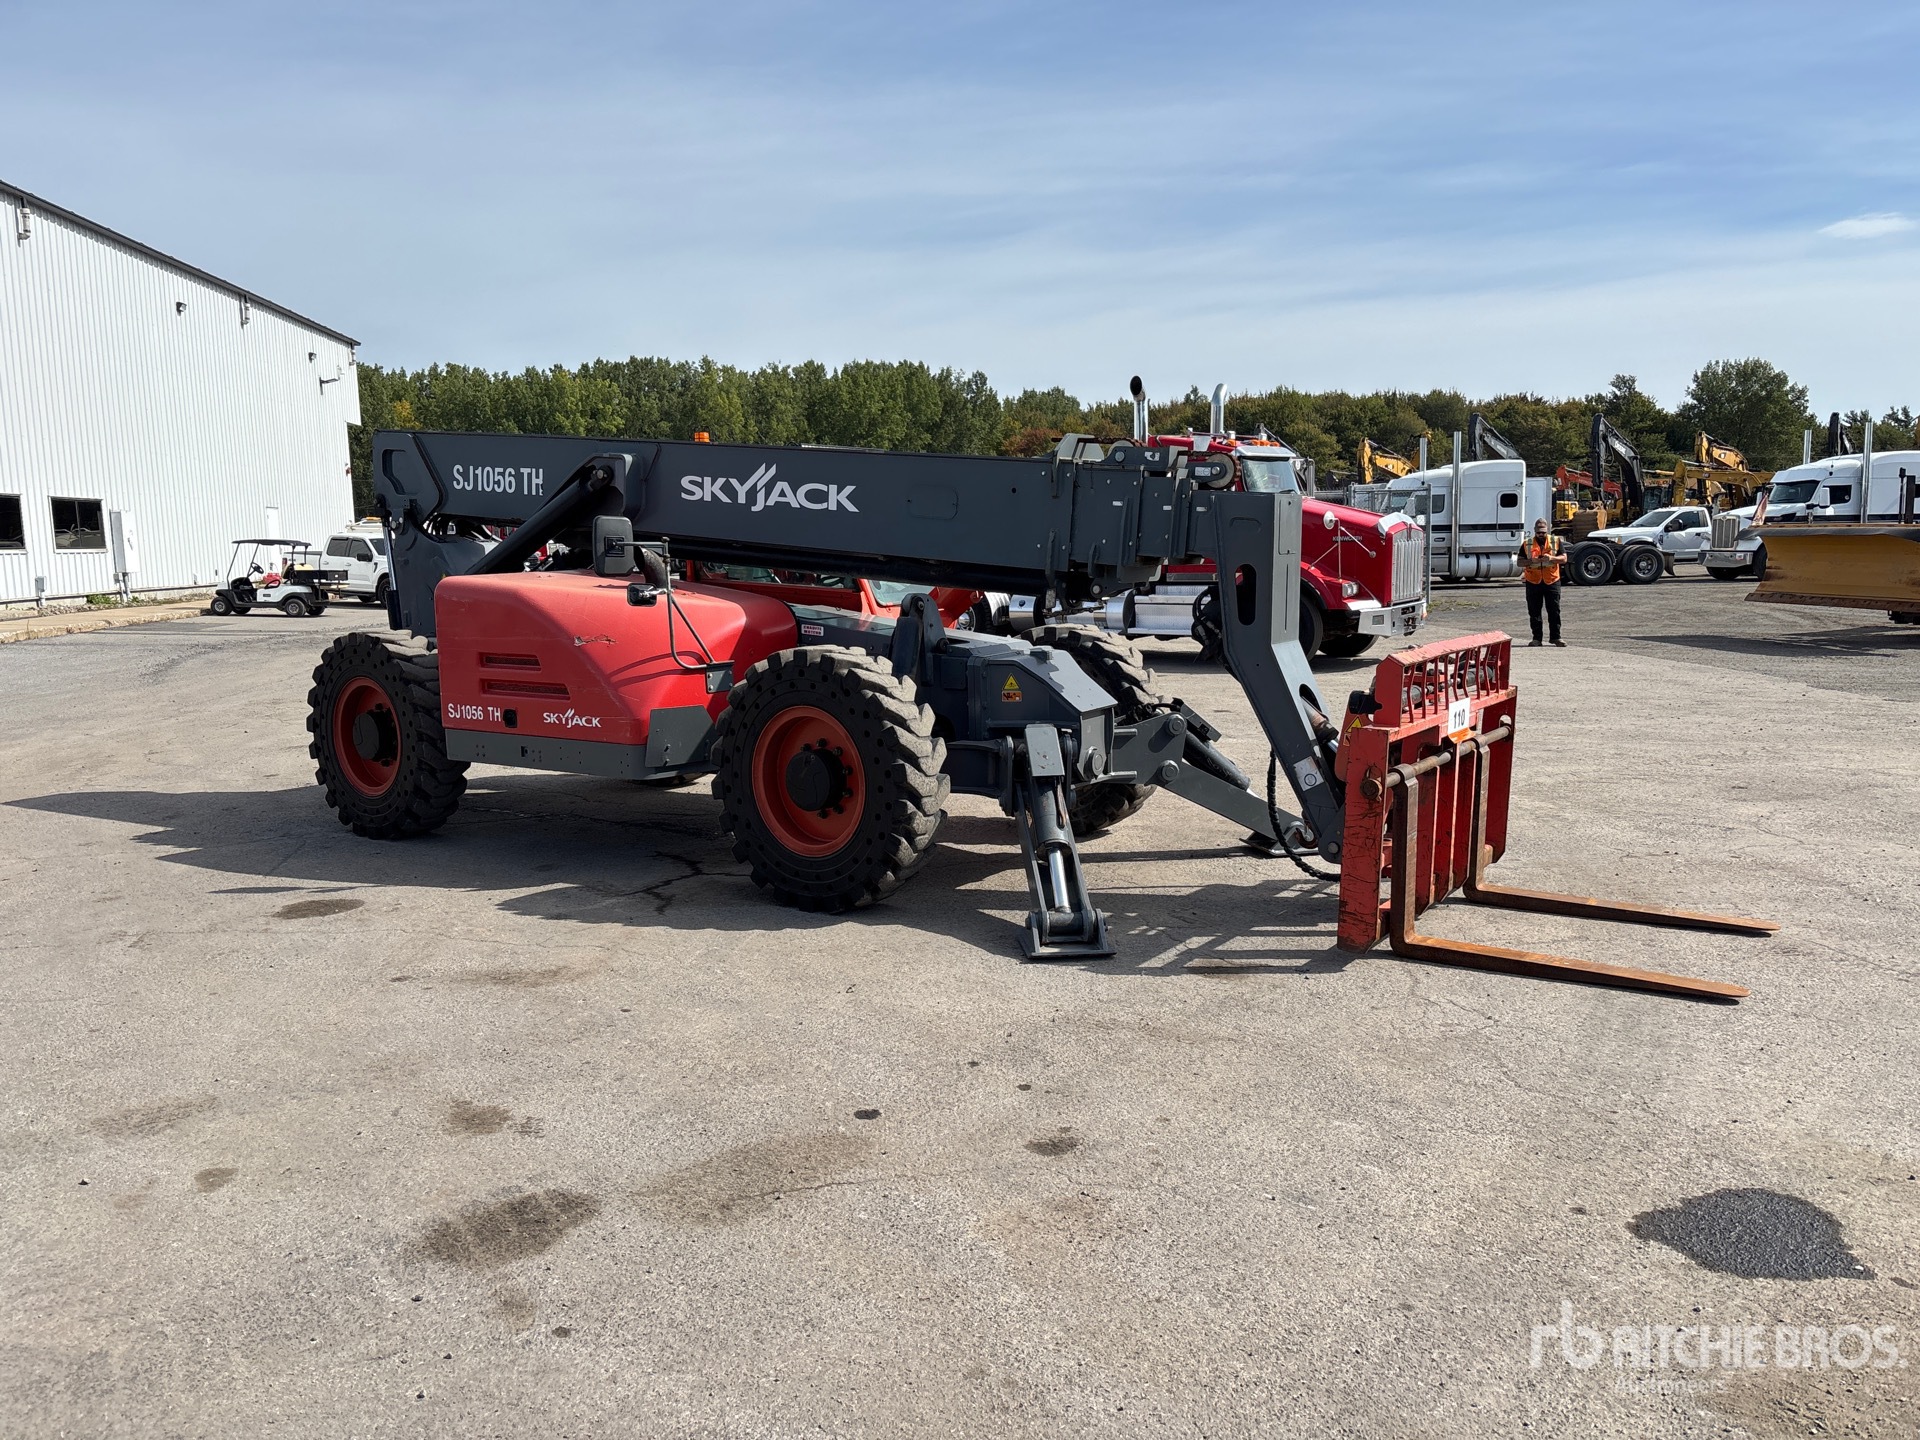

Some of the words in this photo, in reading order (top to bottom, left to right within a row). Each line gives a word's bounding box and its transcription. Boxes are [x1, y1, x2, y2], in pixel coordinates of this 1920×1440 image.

[453, 464, 516, 493] SJ1056
[520, 467, 544, 496] TH
[680, 462, 861, 513] SKYJACK
[447, 703, 484, 720] SJ1056
[487, 706, 501, 722] TH
[543, 708, 602, 728] SKYJACK
[1453, 708, 1466, 729] 110
